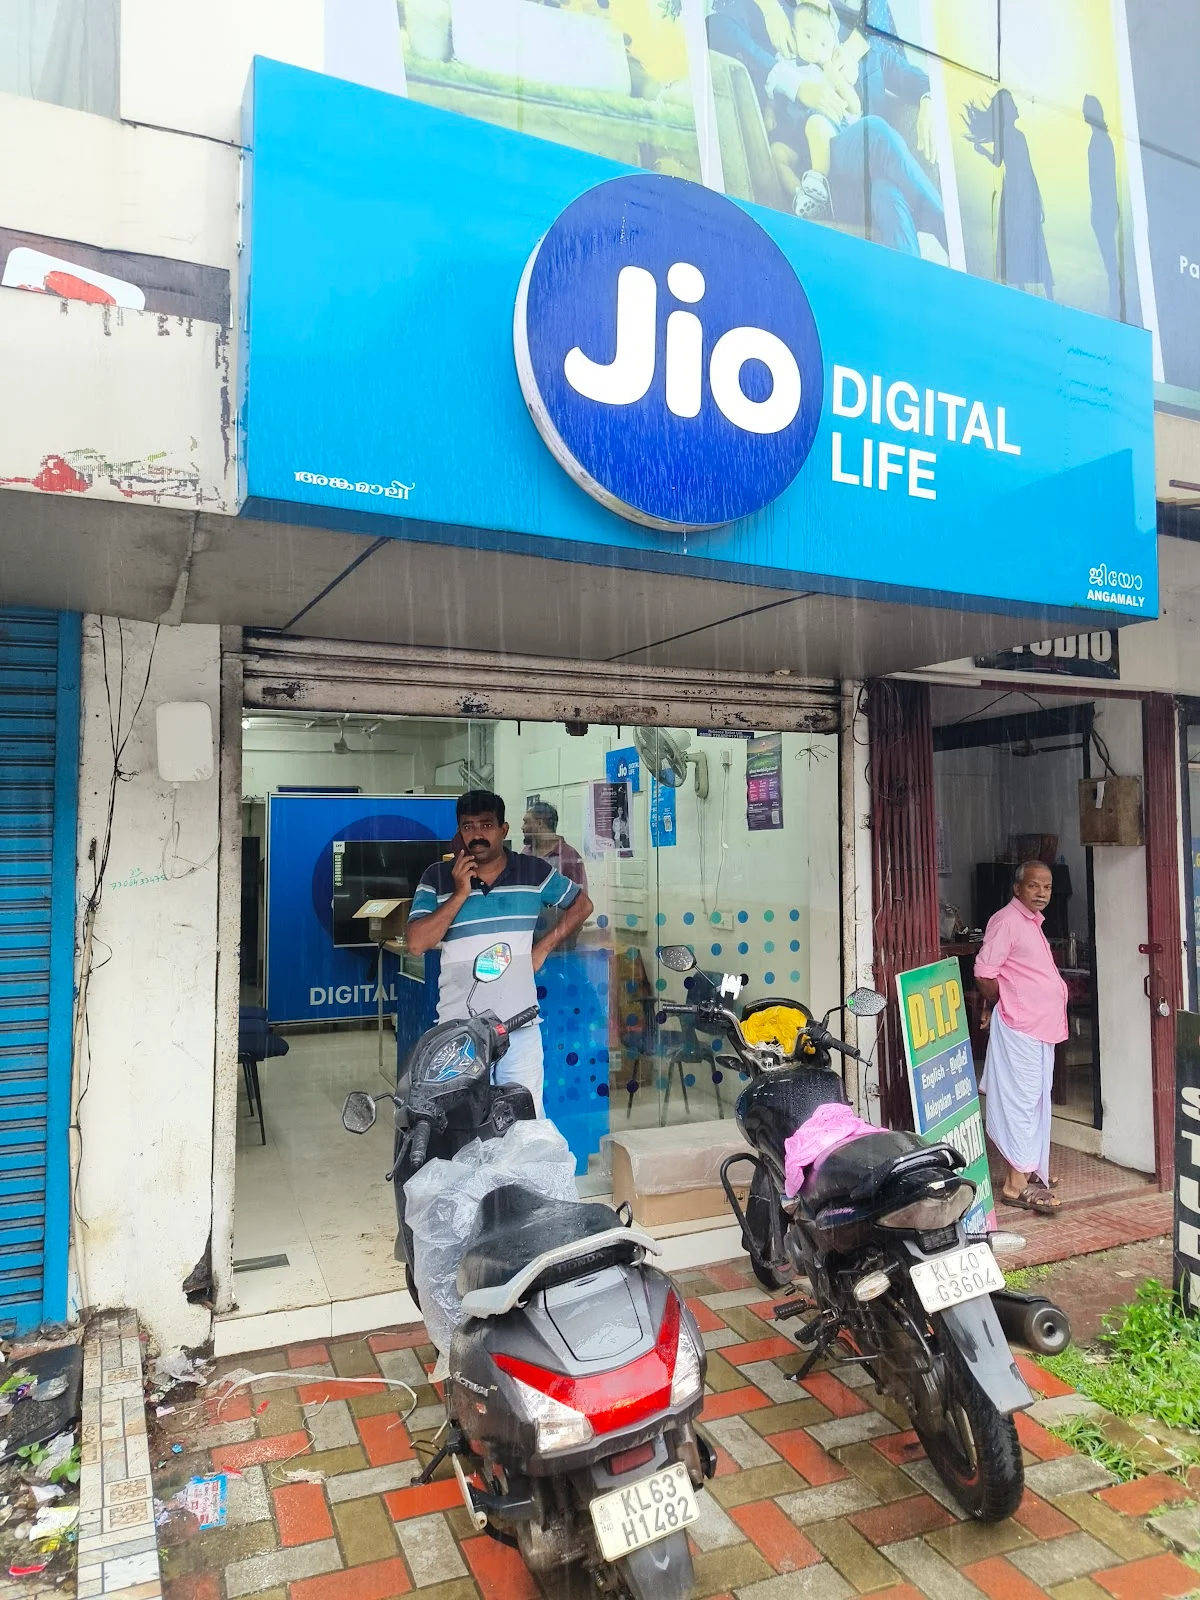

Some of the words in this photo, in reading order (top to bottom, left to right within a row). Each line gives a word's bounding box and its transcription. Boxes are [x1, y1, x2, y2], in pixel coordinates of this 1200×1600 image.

[564, 261, 801, 434] Jio
[832, 364, 1022, 455] DIGITAL
[832, 432, 937, 500] LIFE
[1088, 563, 1143, 591] ജിയോ
[1086, 589, 1145, 608] ANGAMALY
[309, 983, 398, 1006] DIGITAL
[908, 979, 962, 1050] D.T.P
[921, 1064, 946, 1090] English
[924, 1092, 953, 1121] Malayalam
[938, 1268, 998, 1302] G3604
[620, 1473, 677, 1517] KL63
[621, 1495, 693, 1547] H1482
